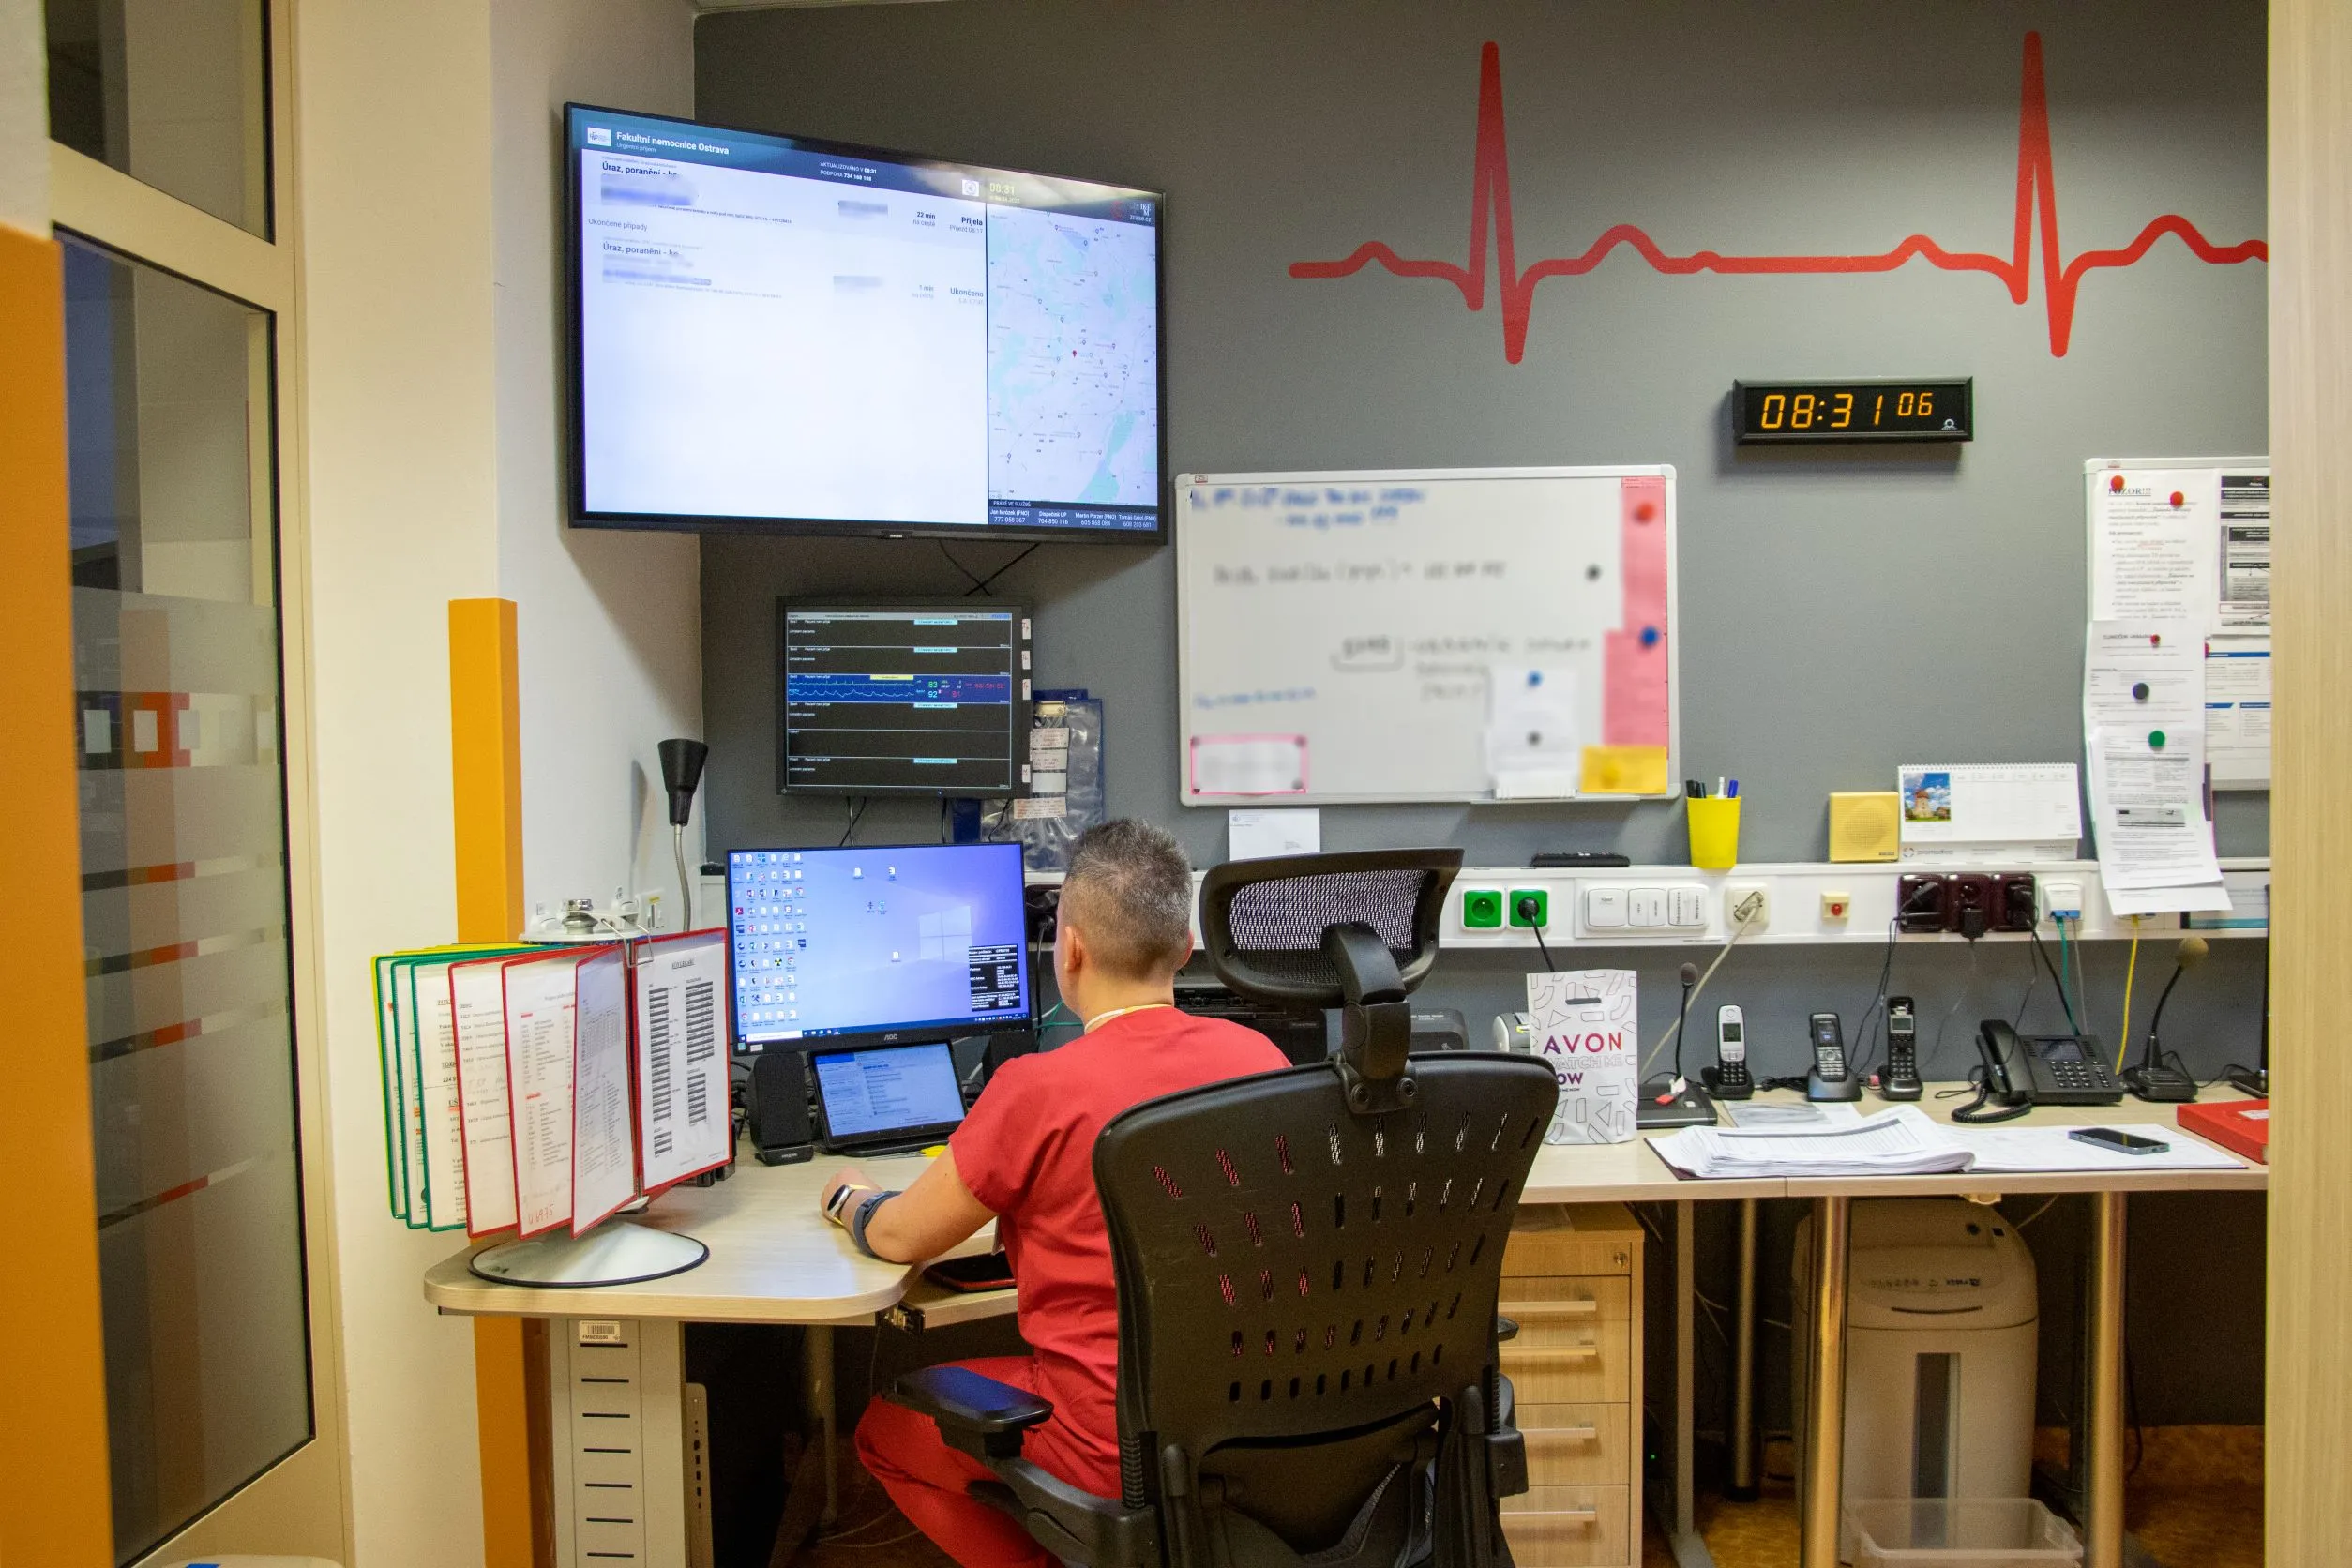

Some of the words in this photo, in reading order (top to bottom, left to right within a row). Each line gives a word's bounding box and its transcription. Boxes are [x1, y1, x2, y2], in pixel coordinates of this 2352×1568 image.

[616, 131, 651, 144] Fakultní
[652, 138, 697, 151] nemocnice
[698, 143, 730, 156] Ostrava
[602, 160, 624, 174] Úraz,
[961, 216, 984, 226] Přijela
[602, 240, 625, 254] Úraz,
[1760, 393, 1884, 430] 08:31
[1897, 392, 1934, 417] 06
[1543, 1032, 1621, 1054] AVON
[1557, 1072, 1584, 1086] OW
